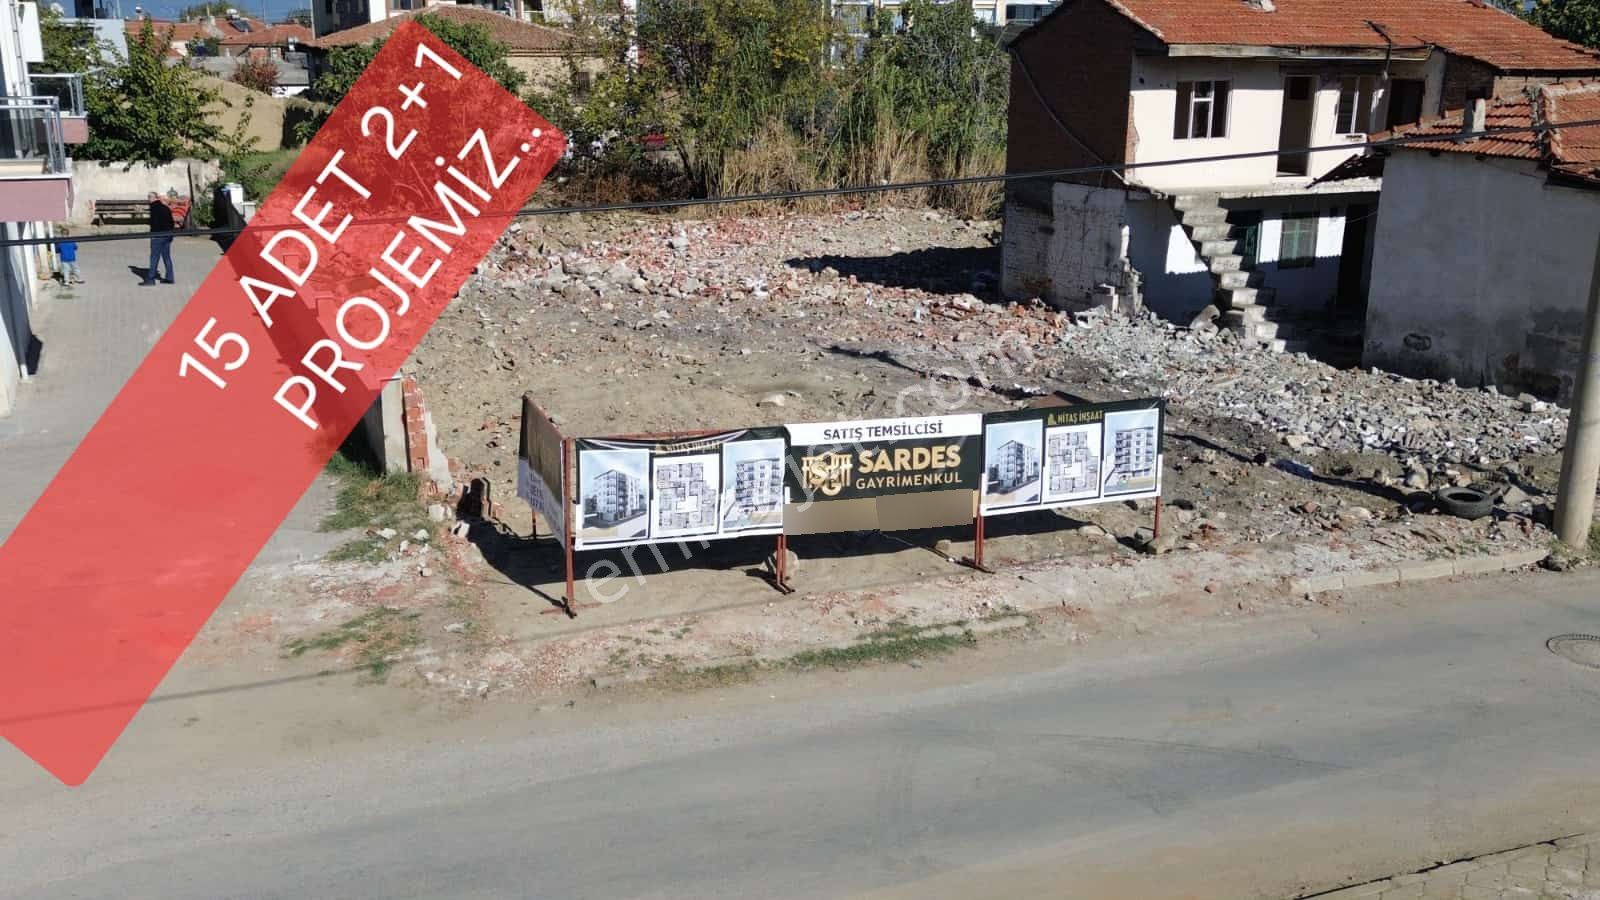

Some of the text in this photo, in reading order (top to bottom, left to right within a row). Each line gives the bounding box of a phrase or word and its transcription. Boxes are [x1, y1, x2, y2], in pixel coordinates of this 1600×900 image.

[823, 420, 943, 441] SATIŞ TEMSİLCİSİ
[858, 445, 961, 473] SARDES
[855, 471, 963, 490] GAYRİMENKUL
